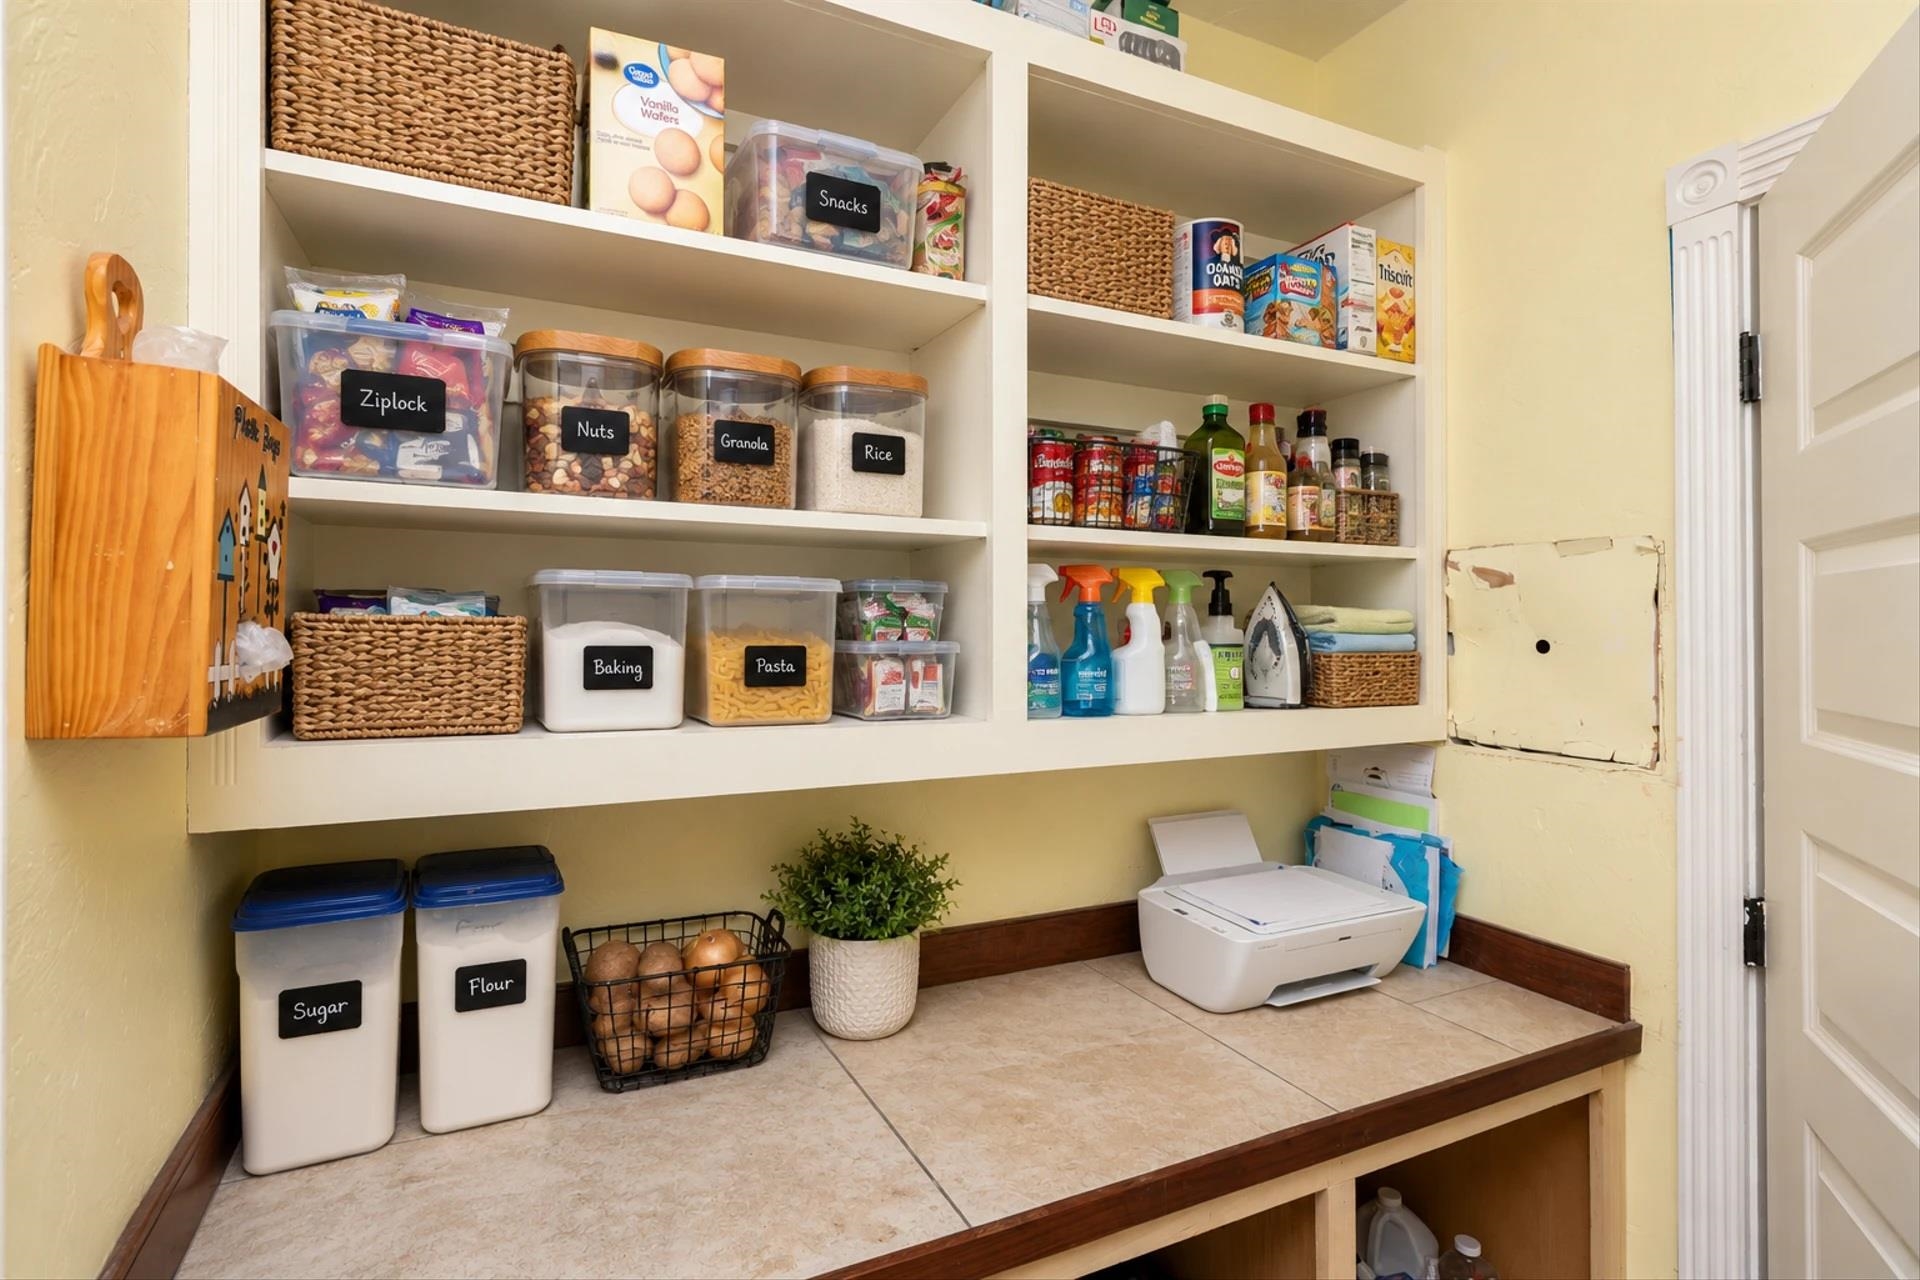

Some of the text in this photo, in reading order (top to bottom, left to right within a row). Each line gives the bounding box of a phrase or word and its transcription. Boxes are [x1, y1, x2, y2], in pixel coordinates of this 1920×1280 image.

[640, 95, 679, 114] Vanilla
[640, 107, 680, 125] Wafers
[819, 189, 868, 215] Snacks
[360, 389, 427, 416] Ziplock
[578, 421, 614, 439] Nuts
[721, 434, 768, 450] Granola
[865, 445, 892, 460] Rice
[594, 659, 642, 681] Baking
[756, 658, 795, 672] Pasta
[469, 978, 513, 995] Flour
[294, 1002, 348, 1024] Sugar
